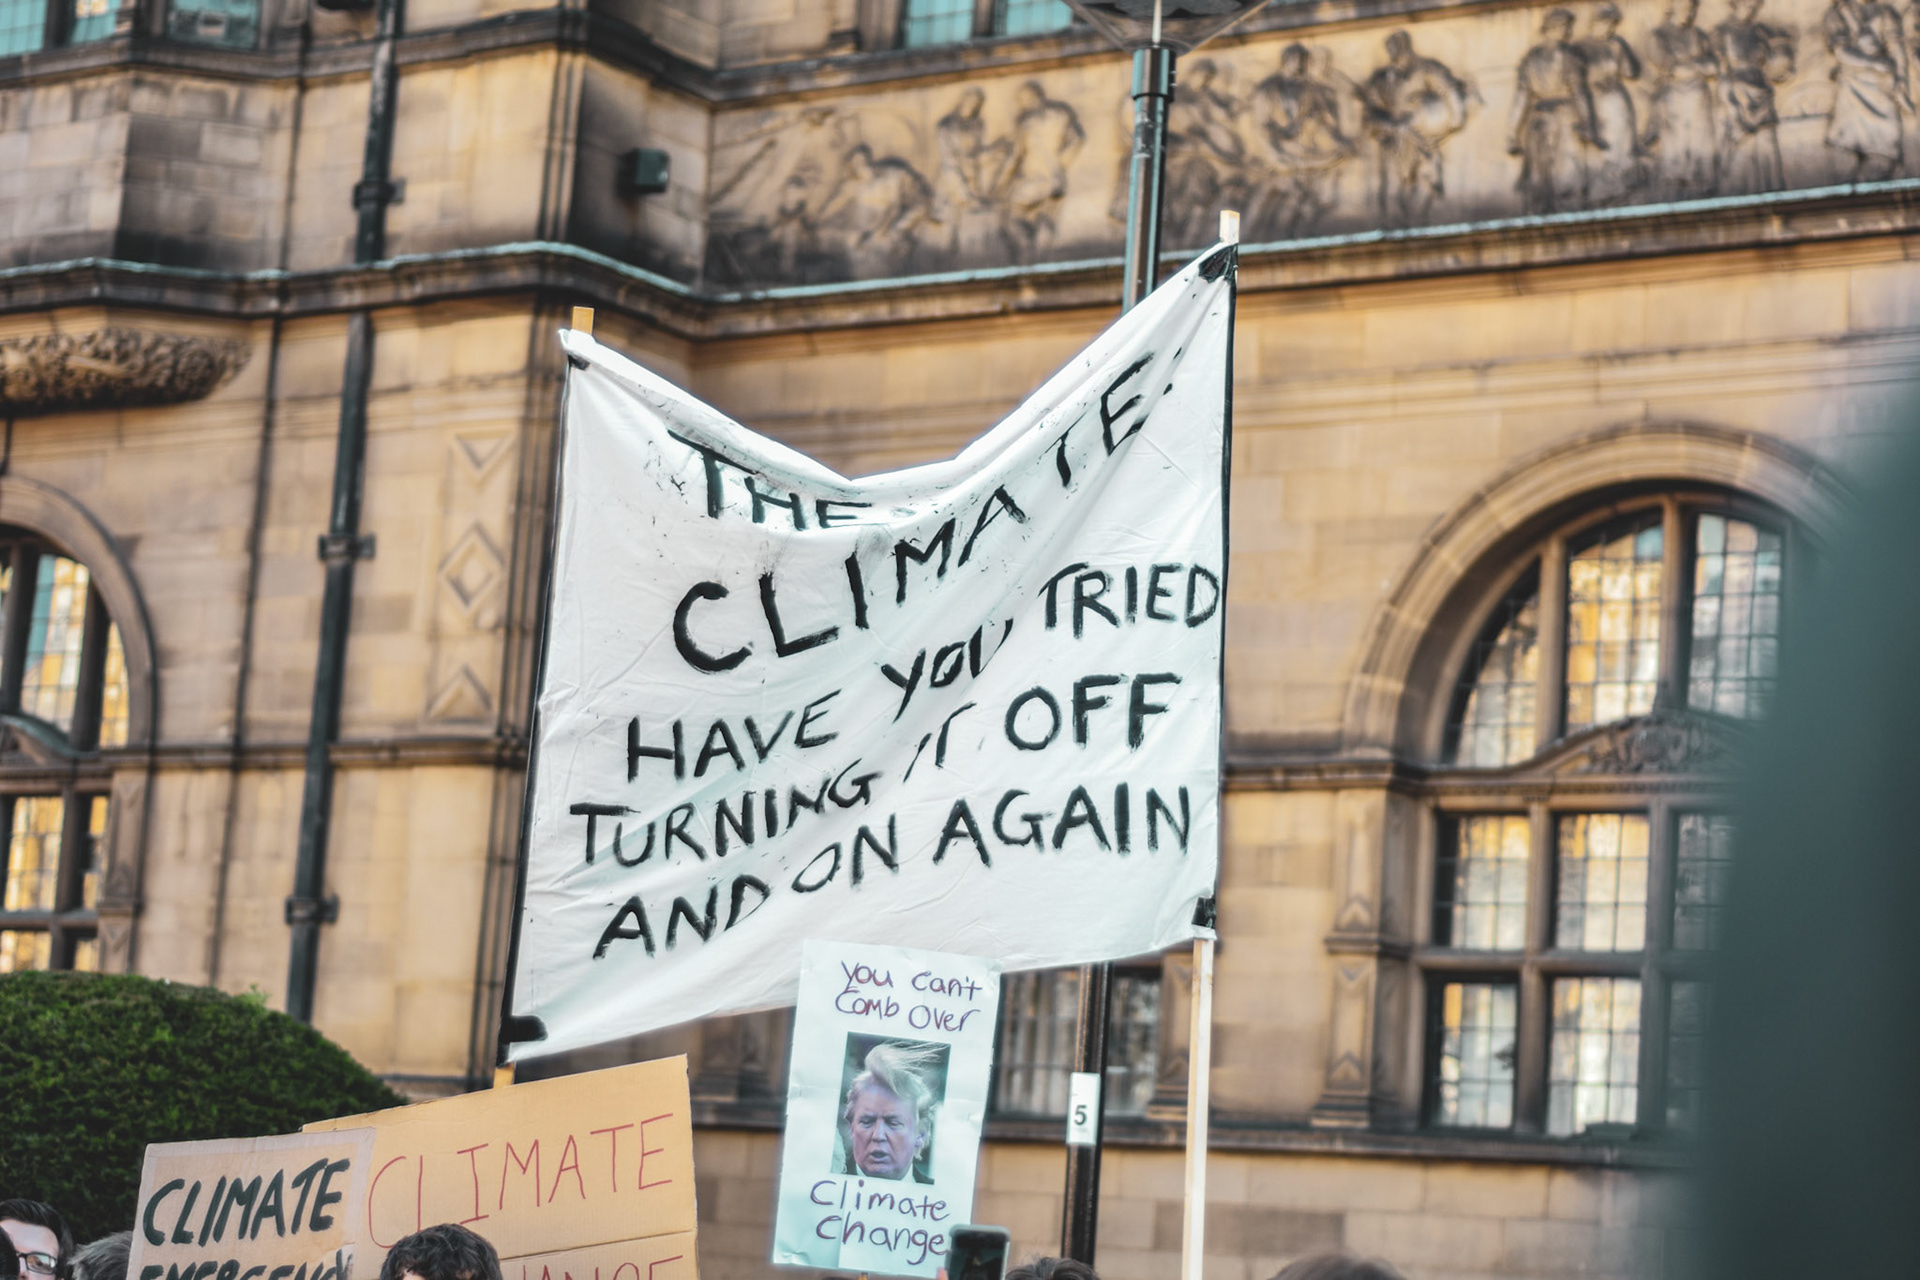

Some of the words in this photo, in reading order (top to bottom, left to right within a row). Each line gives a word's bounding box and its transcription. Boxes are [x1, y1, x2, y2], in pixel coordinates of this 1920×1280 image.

[667, 429, 873, 531] THE
[627, 689, 843, 783] HAVE
[881, 617, 1014, 724] YOU
[1039, 562, 1220, 640] TRIED
[569, 758, 882, 868] TURNING
[1004, 672, 1183, 751] OFF
[593, 873, 771, 960] AND
[791, 813, 899, 888] ON
[932, 783, 1192, 868] AGAIN
[1073, 1104, 1088, 1126] 5
[142, 1157, 350, 1247] CLIMATE
[367, 1112, 674, 1249] CLIMATE
[810, 1179, 950, 1221] Climate
